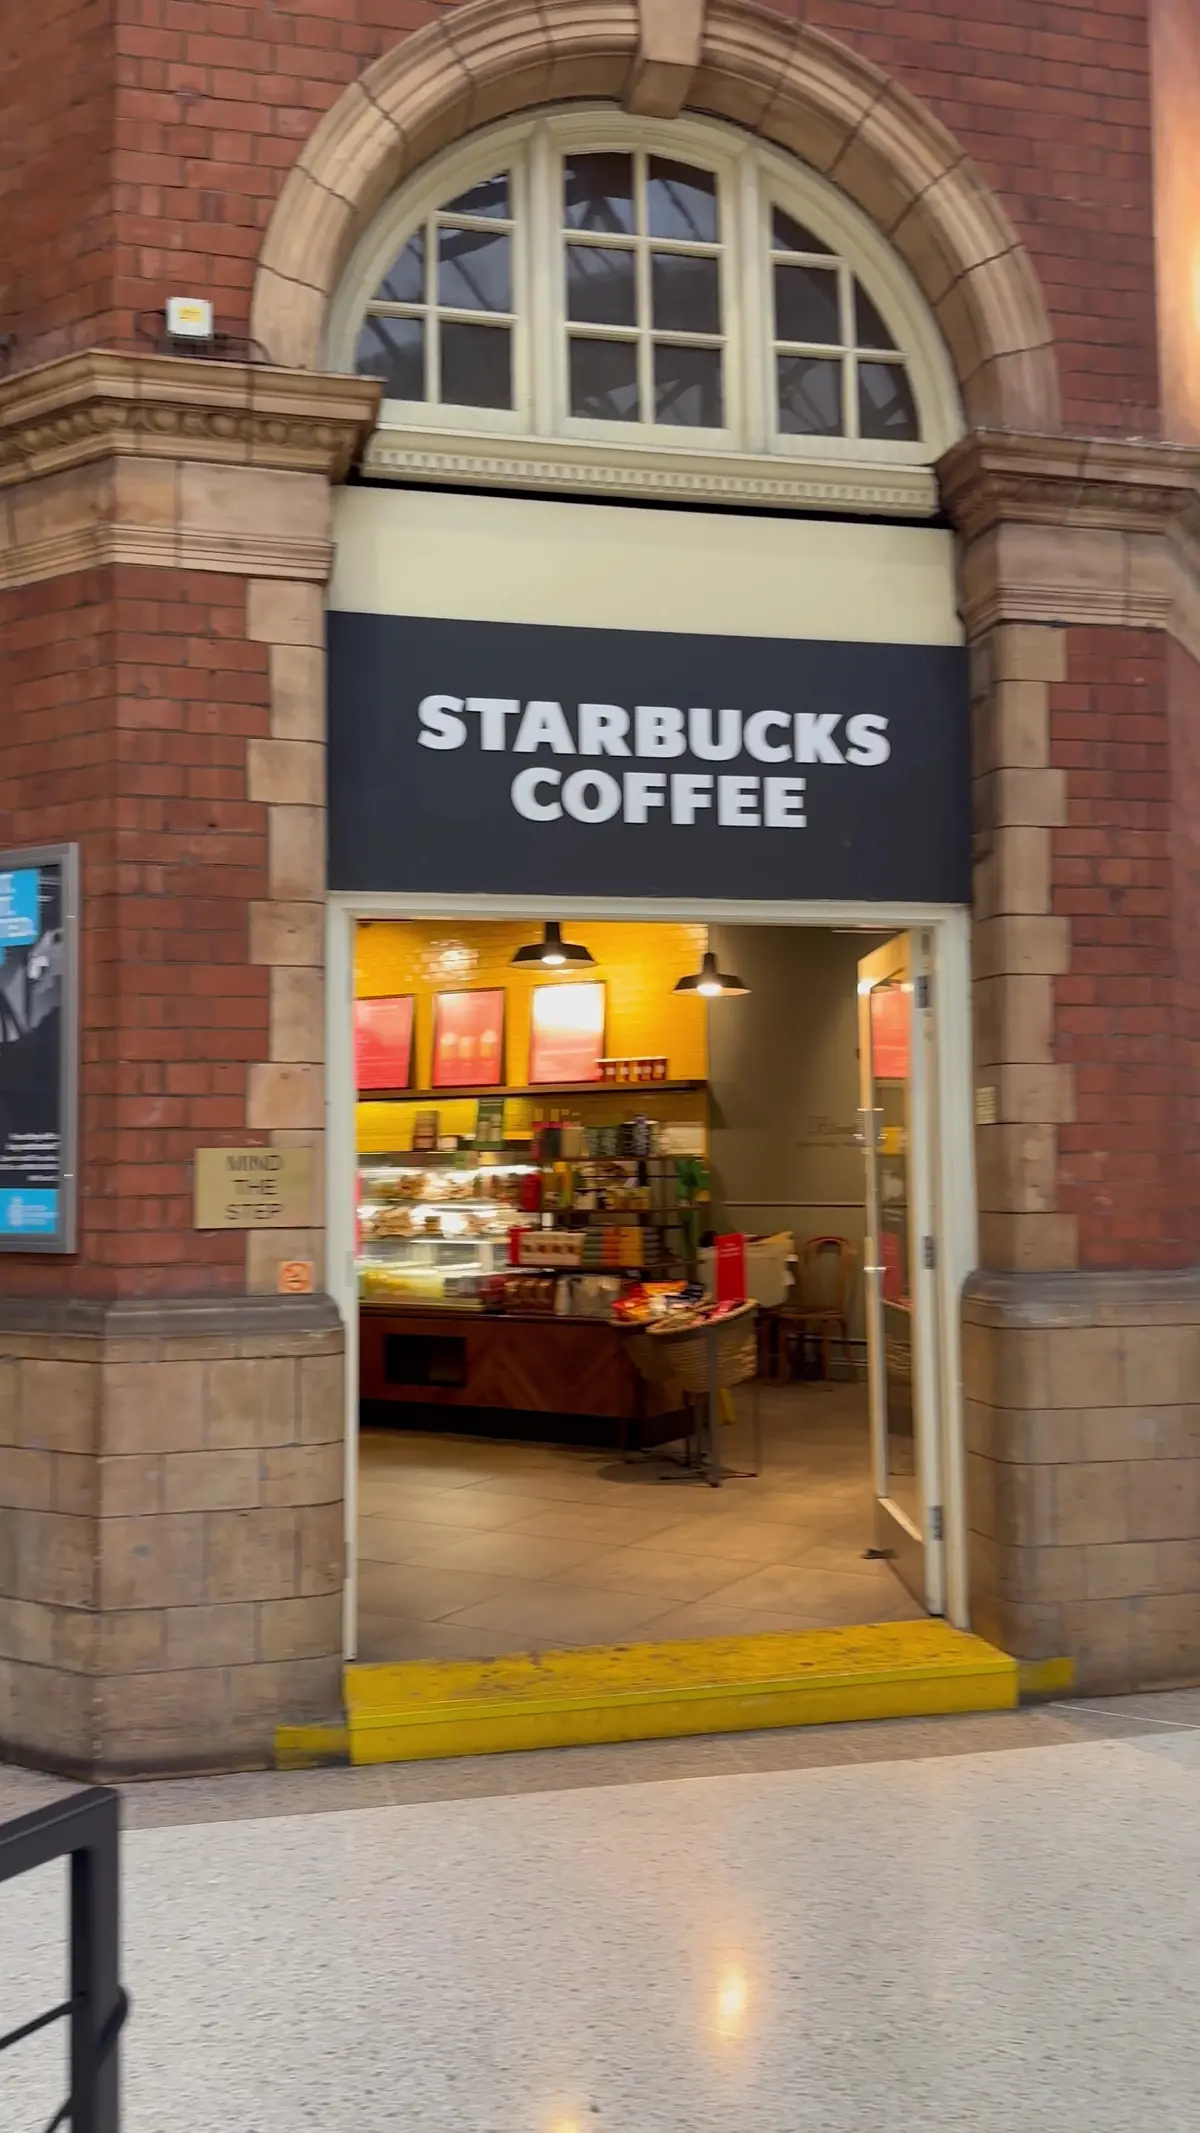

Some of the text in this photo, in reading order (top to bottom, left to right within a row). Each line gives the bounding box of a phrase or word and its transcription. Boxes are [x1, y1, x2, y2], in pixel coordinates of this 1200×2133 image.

[417, 694, 892, 765] STARBUCKS
[510, 767, 808, 829] COFFEE
[226, 1155, 284, 1171] MIND
[231, 1179, 279, 1195] THE
[225, 1203, 285, 1220] STEP
